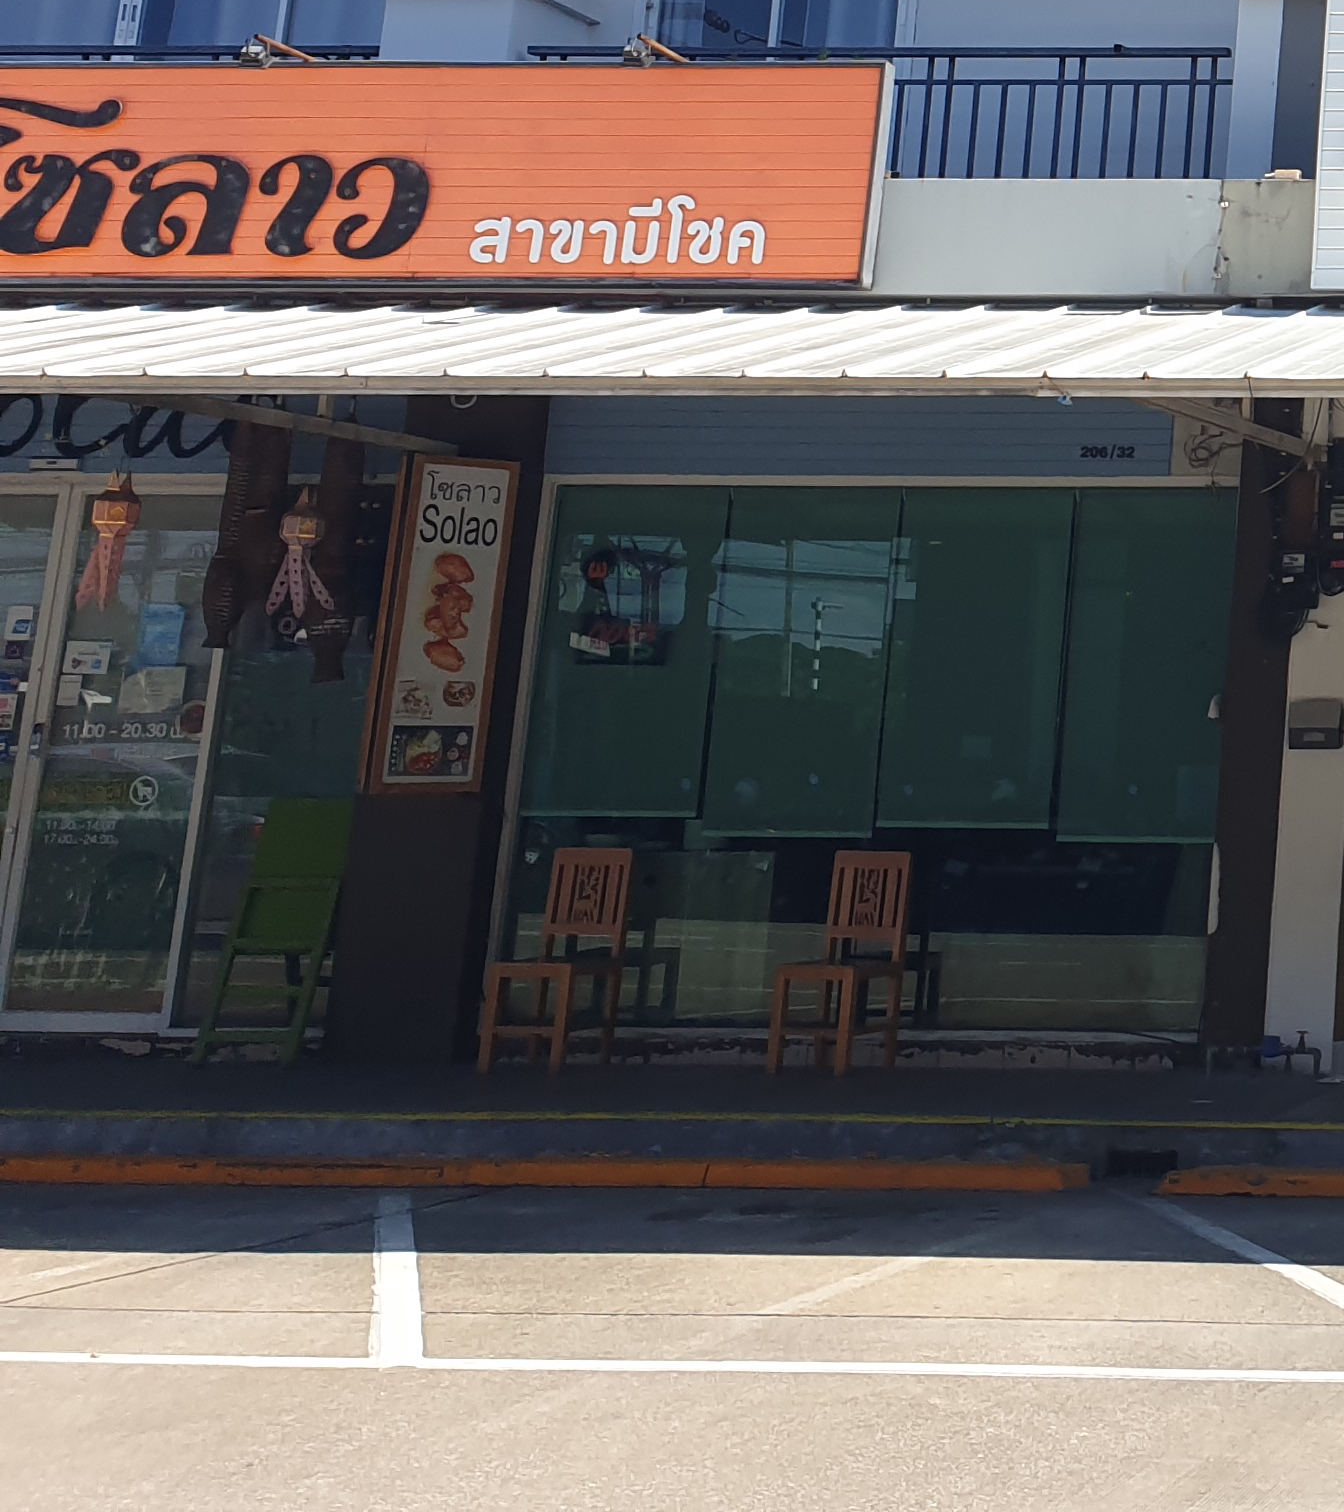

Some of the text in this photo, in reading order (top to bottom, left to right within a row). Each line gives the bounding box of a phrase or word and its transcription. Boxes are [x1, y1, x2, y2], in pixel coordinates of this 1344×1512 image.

[469, 195, 765, 264] สาขามีโชค
[1080, 444, 1136, 460] 206/32
[426, 470, 501, 504] โซลาว
[419, 504, 498, 547] Solao
[121, 723, 167, 738] 20.30
